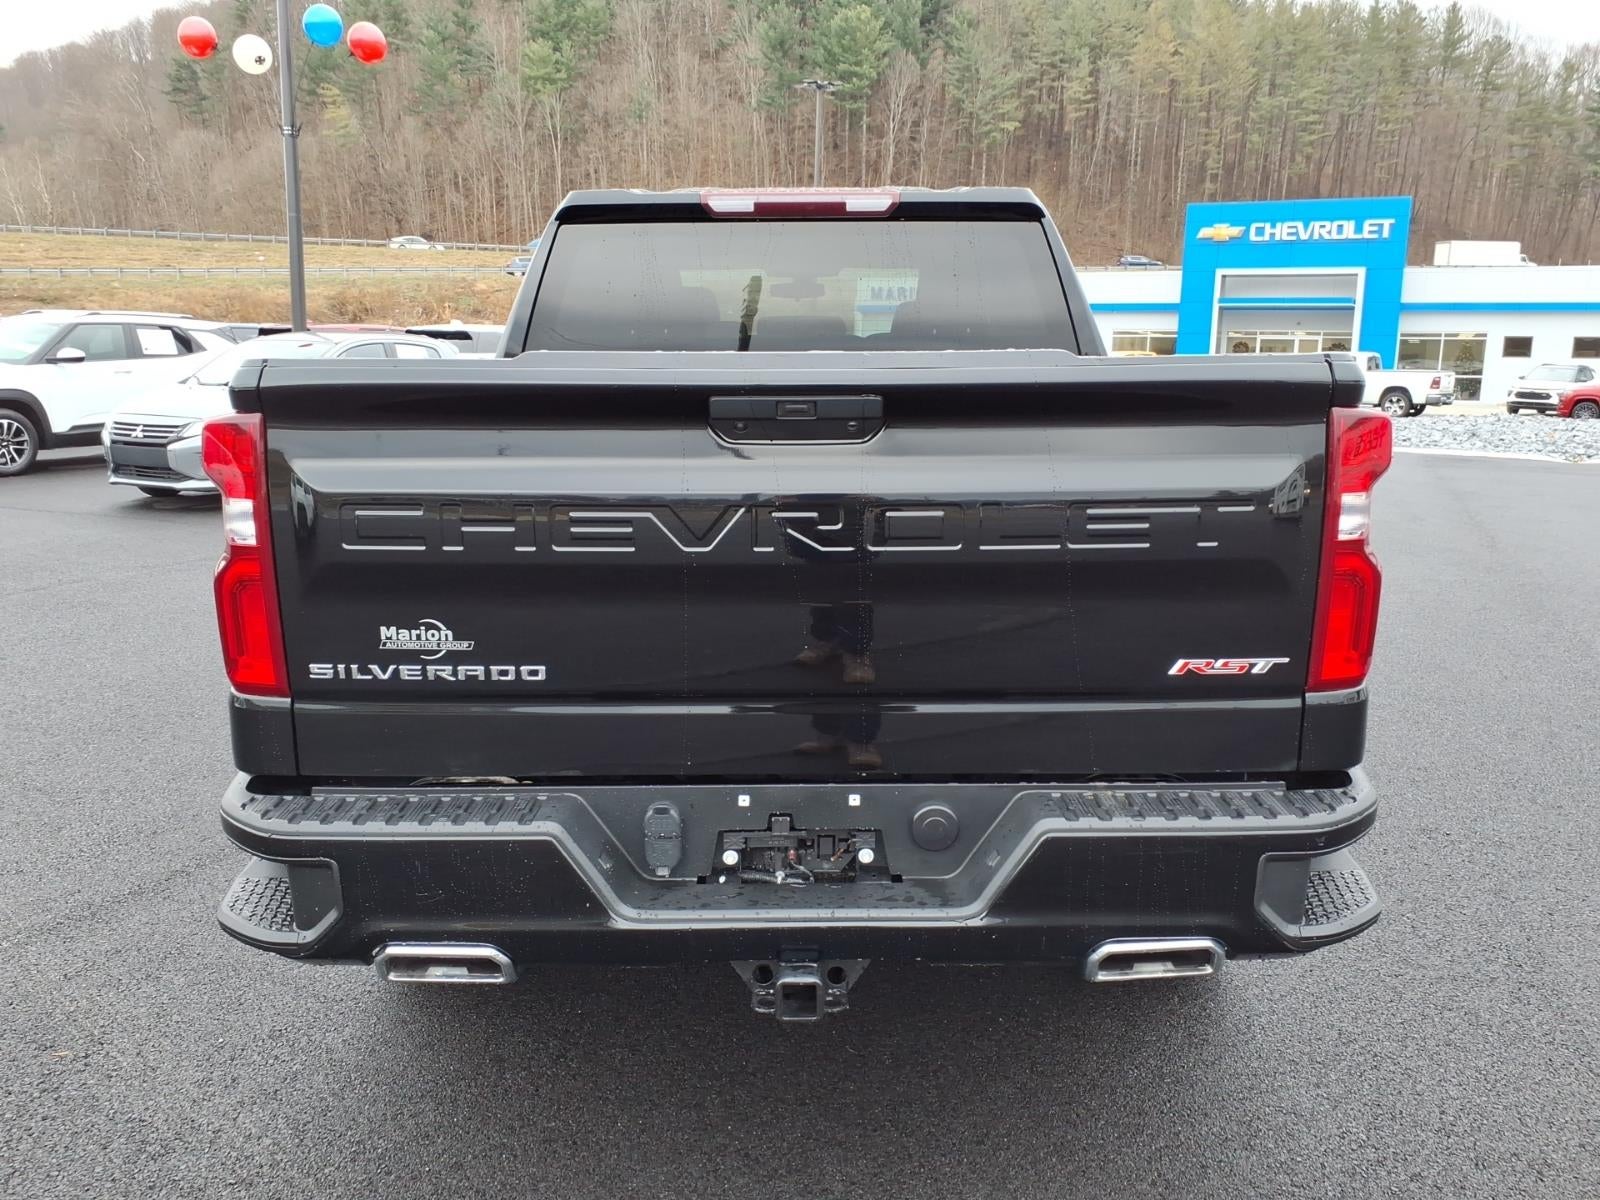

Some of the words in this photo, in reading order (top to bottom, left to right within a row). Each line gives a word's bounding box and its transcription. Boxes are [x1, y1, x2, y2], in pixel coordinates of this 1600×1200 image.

[1249, 218, 1396, 242] CHEVROLET
[339, 501, 1256, 552] CHEVROLET
[379, 626, 453, 642] Marion
[386, 641, 438, 649] AUTOMOTIVE
[440, 642, 470, 650] GROUP
[308, 663, 547, 681] SILVERADO
[1167, 657, 1290, 675] RST
